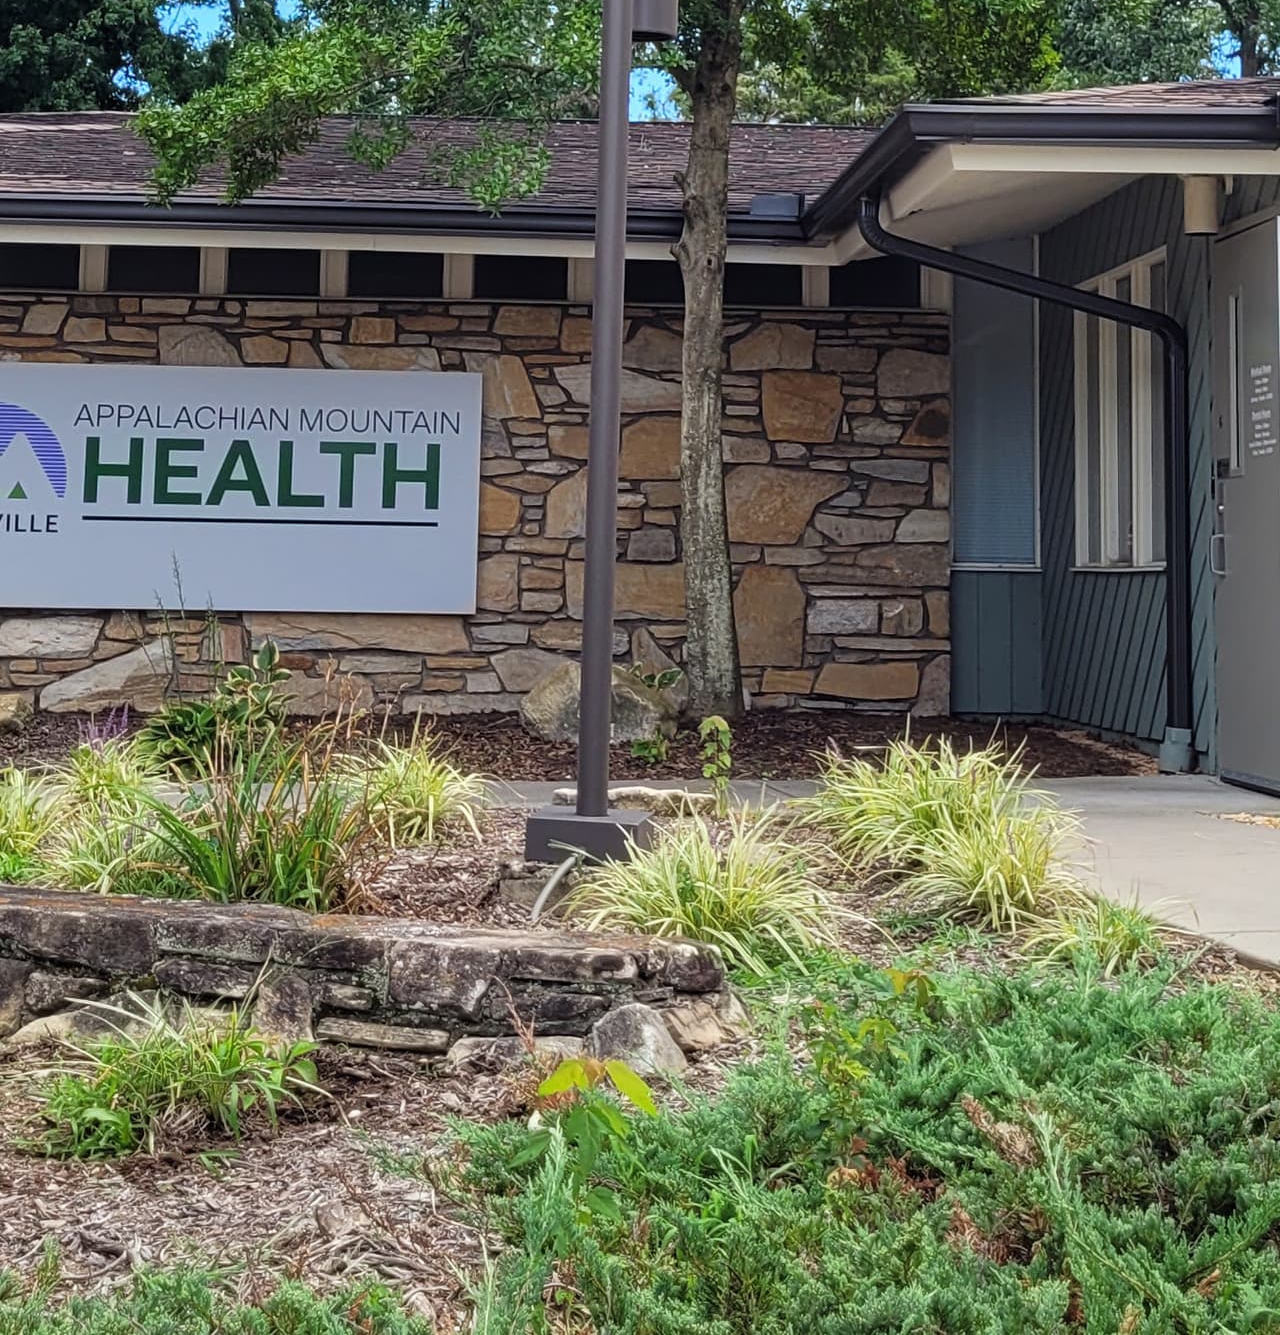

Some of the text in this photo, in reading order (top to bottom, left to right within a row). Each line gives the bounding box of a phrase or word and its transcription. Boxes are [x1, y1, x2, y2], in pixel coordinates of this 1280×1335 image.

[73, 403, 461, 435] APPALACHIAN MOUNTAIN
[82, 436, 442, 510] HEALTH
